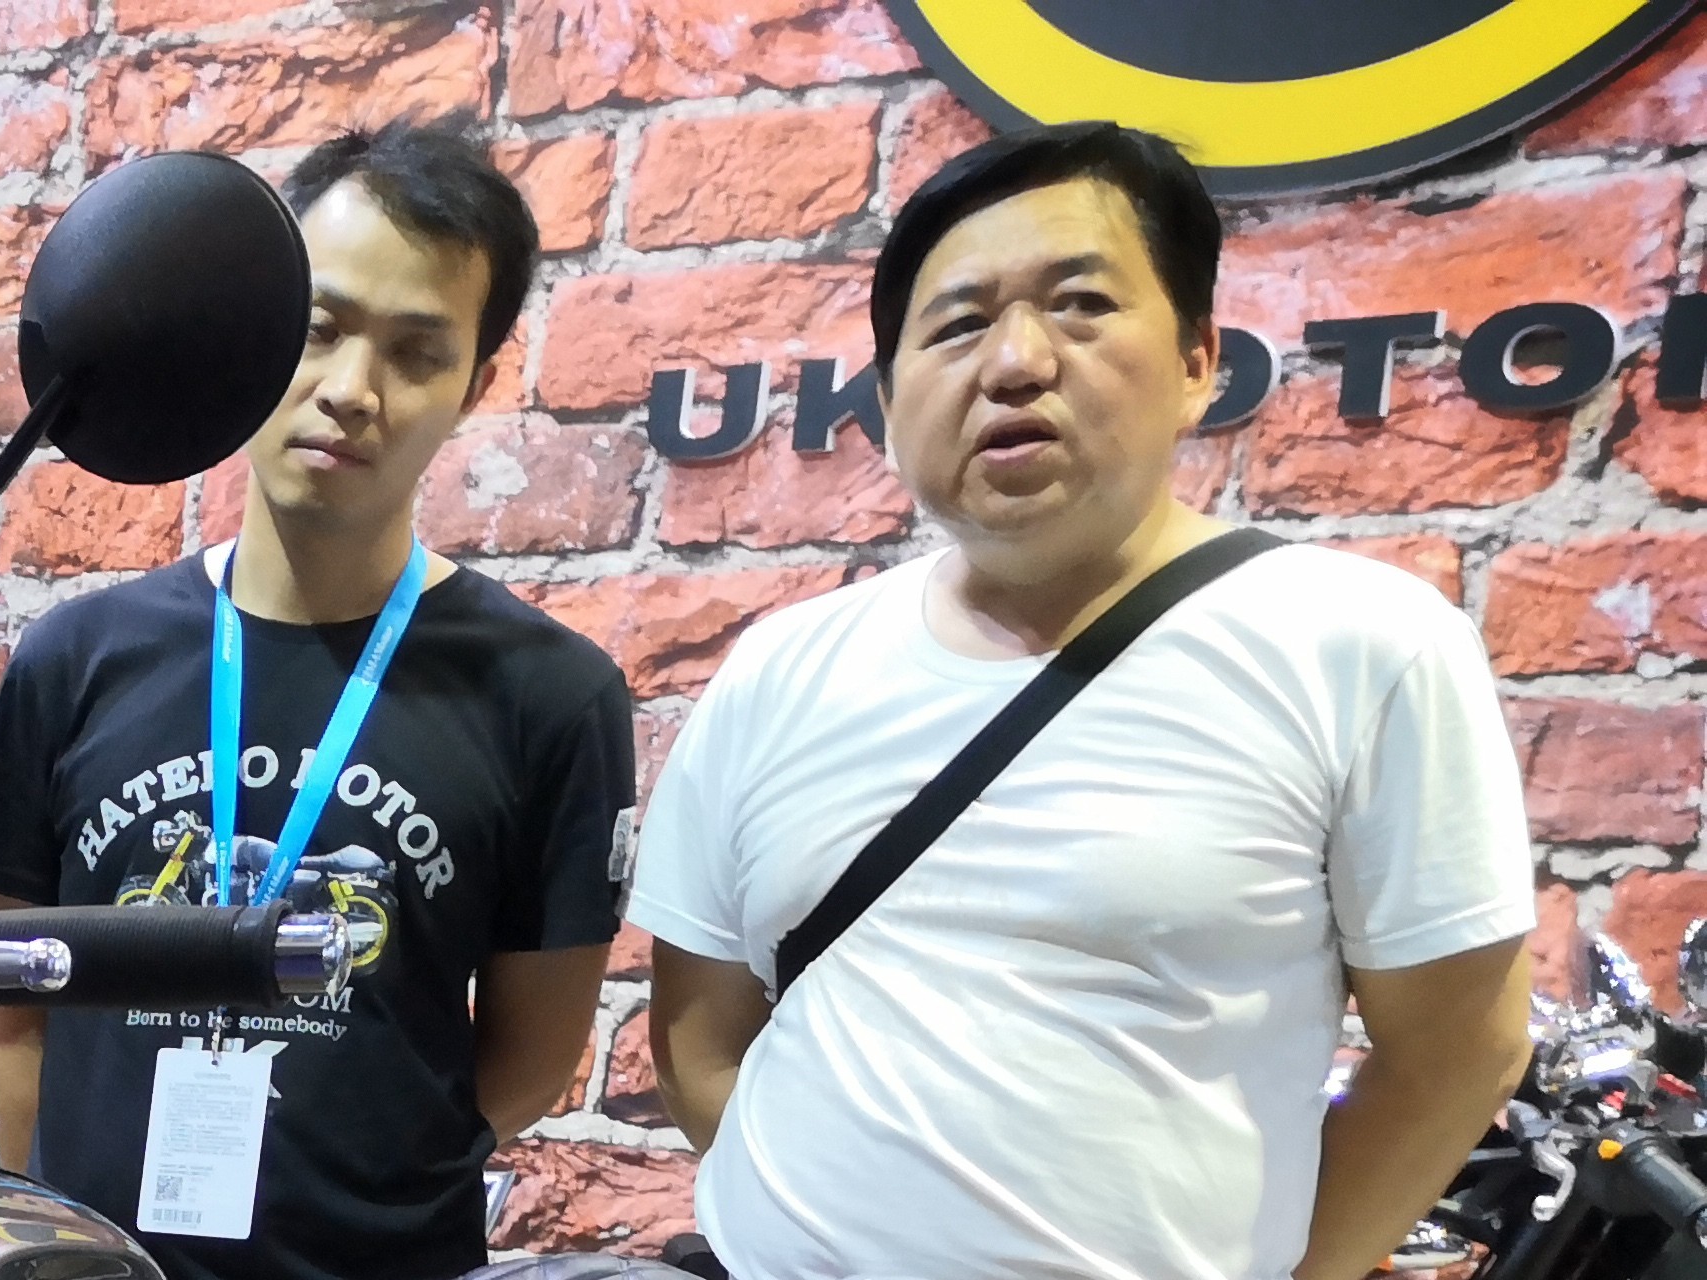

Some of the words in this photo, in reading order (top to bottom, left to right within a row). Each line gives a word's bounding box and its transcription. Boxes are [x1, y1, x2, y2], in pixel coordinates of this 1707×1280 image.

[126, 1008, 172, 1027] Born
[179, 1010, 201, 1028] to
[238, 1013, 348, 1042] somebody
